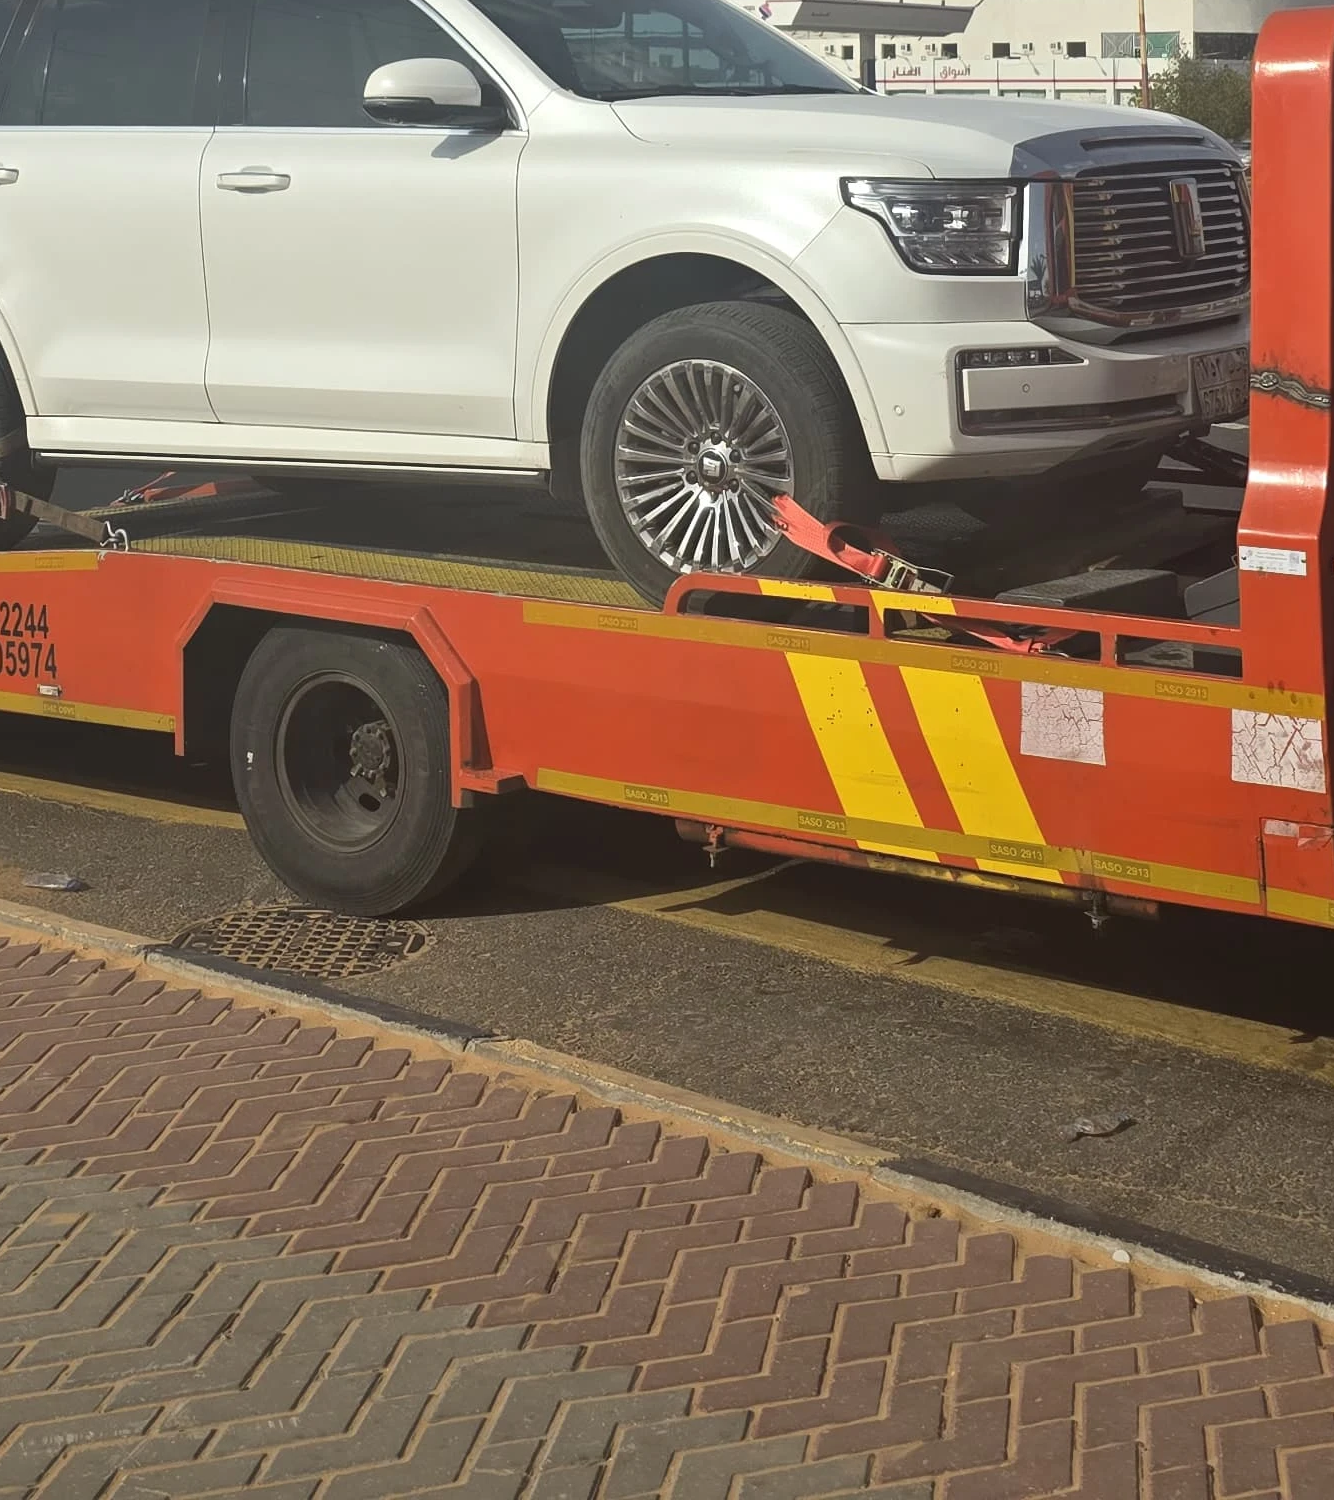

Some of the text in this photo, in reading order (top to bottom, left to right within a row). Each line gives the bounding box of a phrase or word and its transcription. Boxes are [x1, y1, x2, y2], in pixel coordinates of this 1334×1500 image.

[952, 657, 999, 673] SASO 2913
[1156, 683, 1208, 699] SASO 2913
[799, 814, 846, 832] SASO 2913
[990, 843, 1043, 861] SASO 2913
[1093, 858, 1149, 879] SASO 2913
